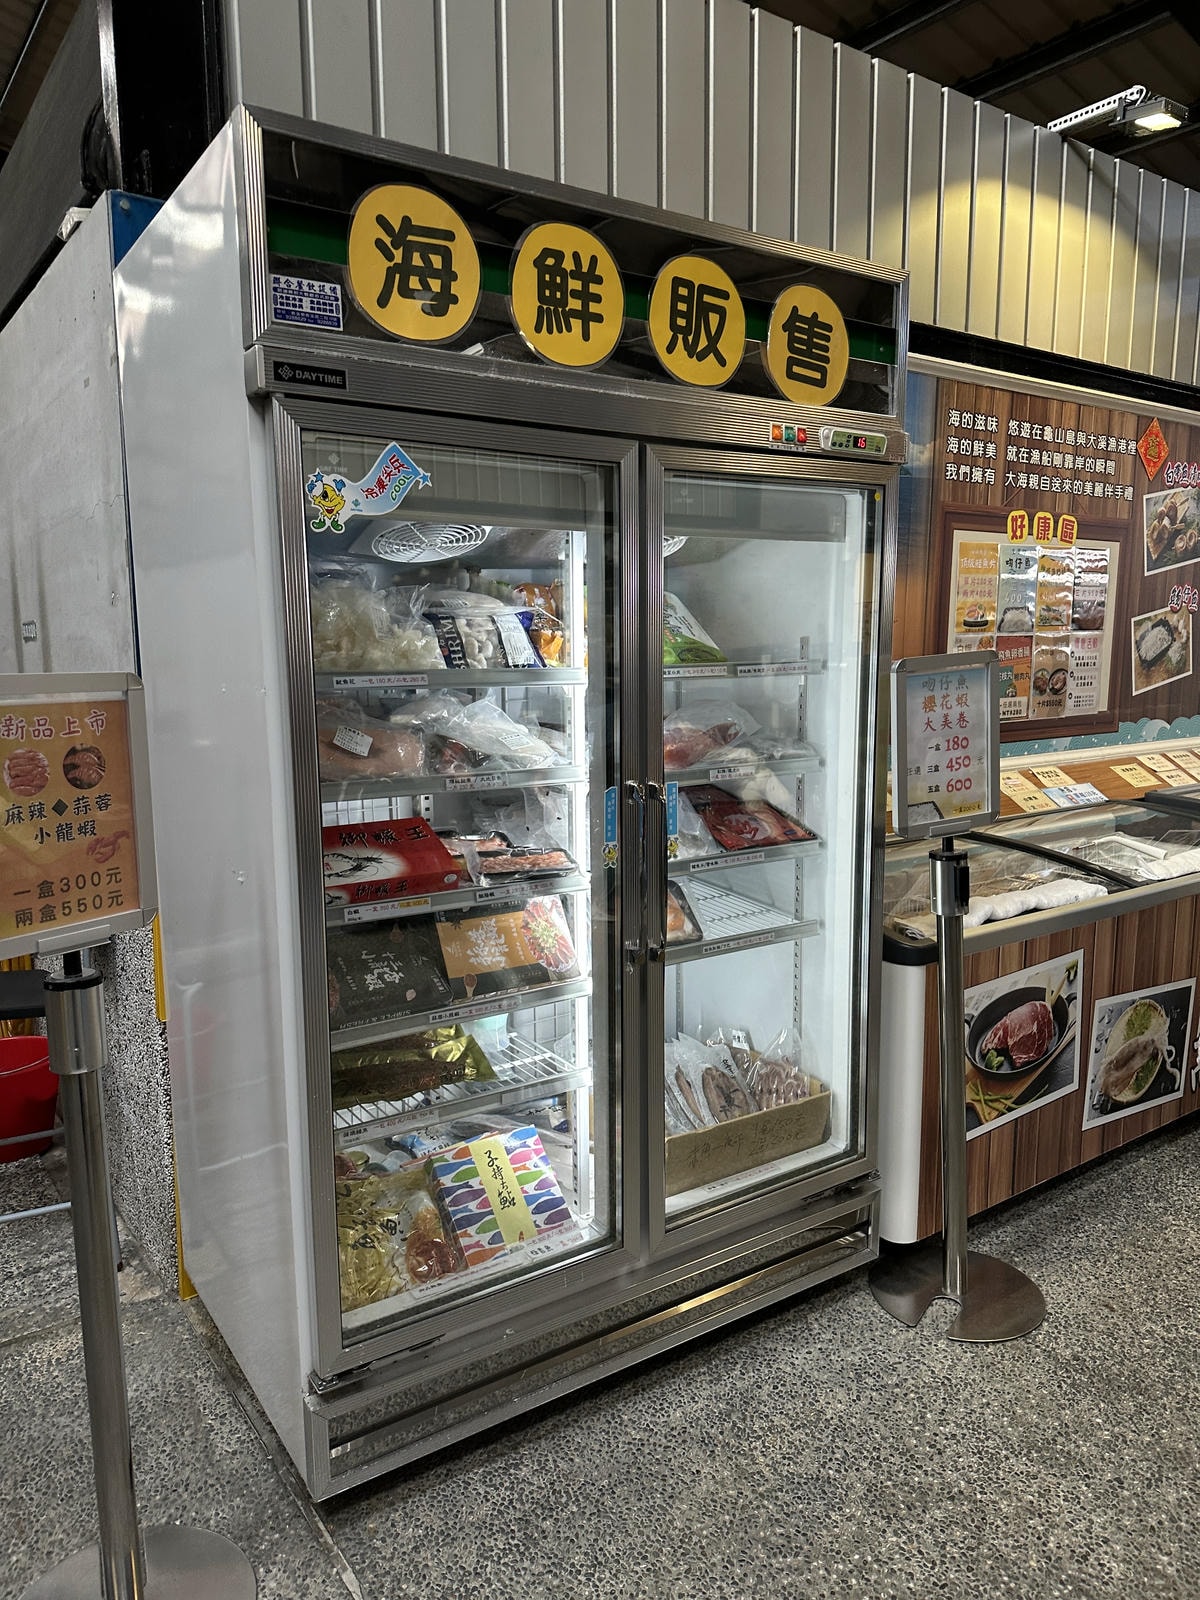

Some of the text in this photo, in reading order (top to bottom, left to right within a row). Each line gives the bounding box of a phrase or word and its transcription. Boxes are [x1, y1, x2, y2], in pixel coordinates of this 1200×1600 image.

[374, 213, 834, 390] 海鮮販售
[295, 369, 343, 385] DAYTIME
[948, 409, 999, 434] 海的滋味
[1007, 419, 1137, 456] 悠遊在龜山島與大溪漁港裡
[946, 436, 998, 460] 海的鮮美
[1006, 445, 1116, 477] 就在漁船剛靠岸的瞬間
[361, 453, 412, 500] 冷凍尖兵
[390, 474, 414, 502] COOL
[945, 463, 1134, 502] 我們擁有 大海親自送來的美麗伴手禮
[1010, 513, 1076, 545] 好康區
[921, 674, 970, 692] 吻仔魚
[921, 692, 971, 713] 櫻花蝦
[1, 710, 108, 741] 新品上市
[922, 711, 971, 733] 大美卷
[927, 735, 970, 752] 一盒 180
[927, 764, 941, 774] 三盒
[945, 755, 971, 773] 450
[927, 777, 973, 794] 五盒 600
[4, 793, 113, 827] 麻辣 蒜蓉
[34, 819, 98, 845] 小龍蝦
[13, 866, 123, 899] 一盒300元
[14, 889, 124, 928] 兩盒550元
